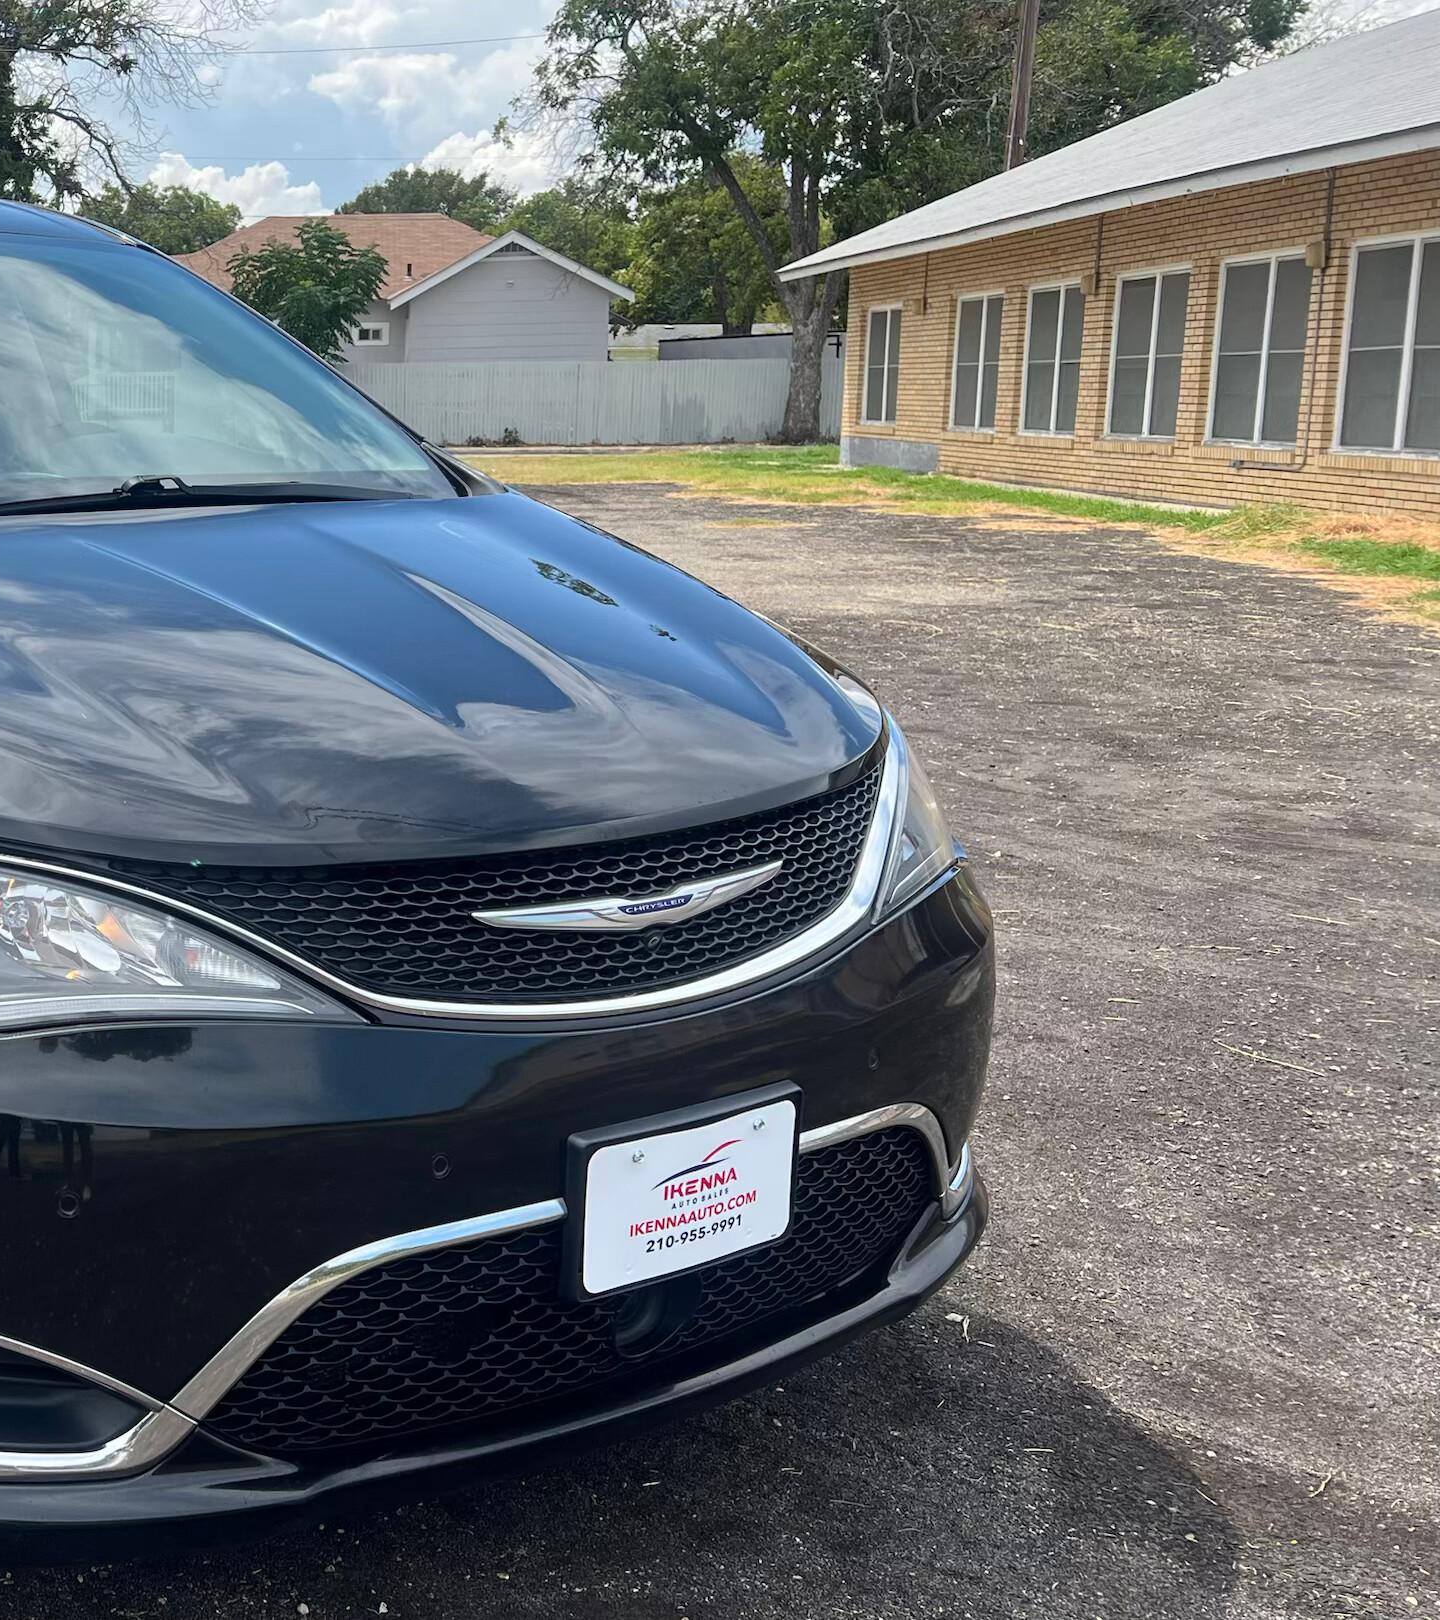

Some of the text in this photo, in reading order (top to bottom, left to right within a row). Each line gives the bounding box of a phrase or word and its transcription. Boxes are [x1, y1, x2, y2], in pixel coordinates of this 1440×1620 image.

[625, 898, 685, 913] CHRYSLER
[663, 1167, 738, 1201] IKENNA
[671, 1187, 729, 1210] AUTO SALES
[629, 1189, 757, 1238] IKENNAAUTO.COM
[645, 1213, 742, 1253] 210-955-9991
